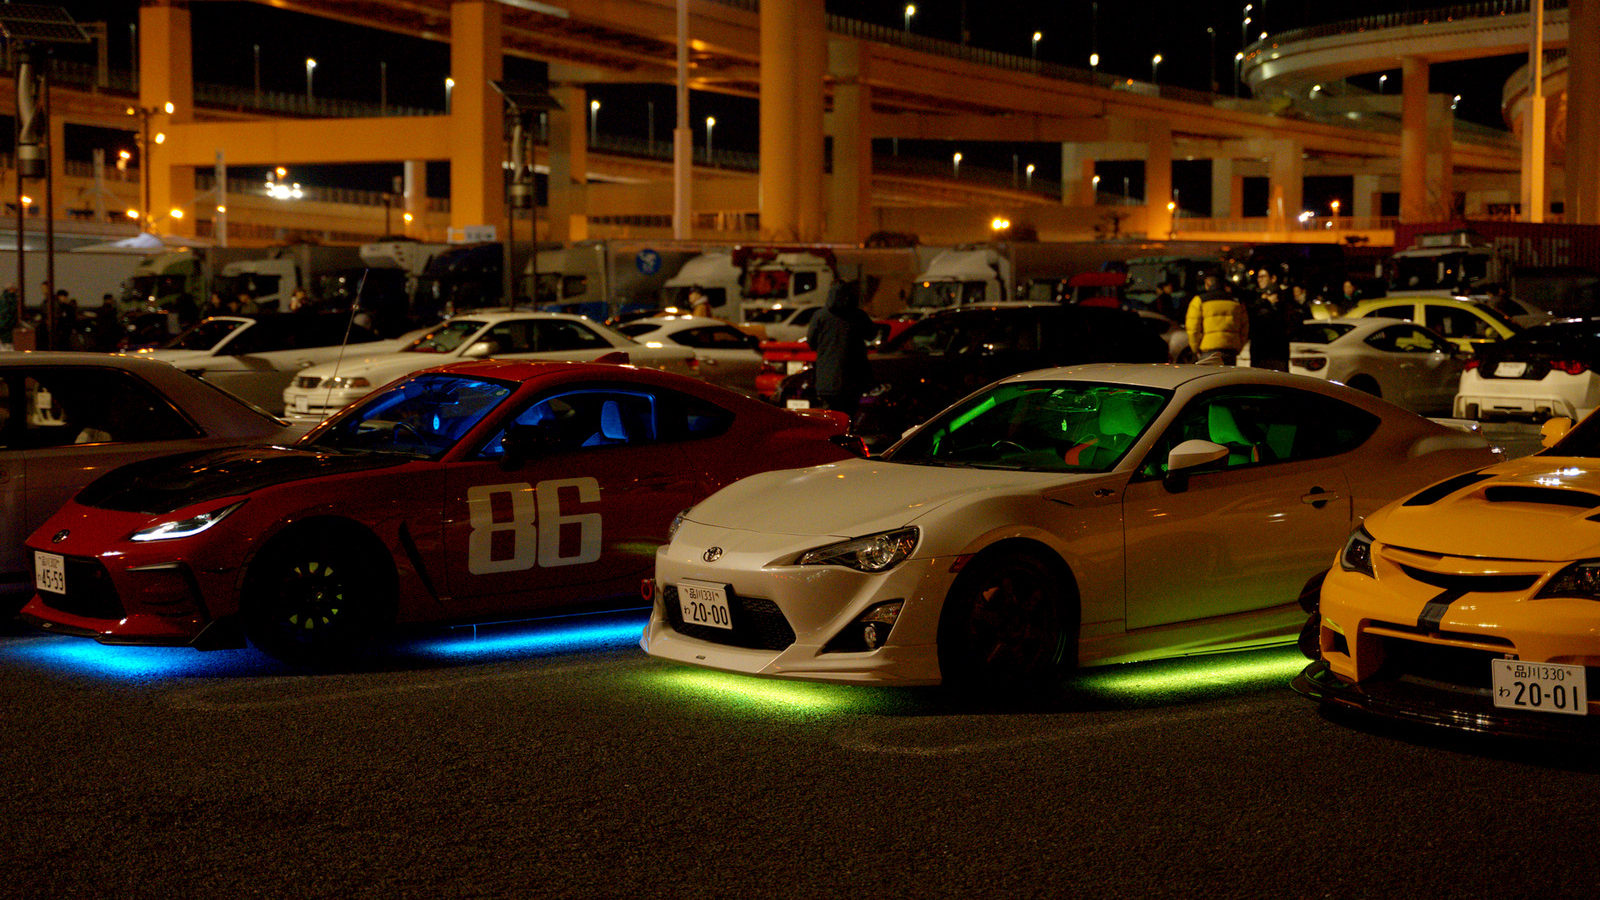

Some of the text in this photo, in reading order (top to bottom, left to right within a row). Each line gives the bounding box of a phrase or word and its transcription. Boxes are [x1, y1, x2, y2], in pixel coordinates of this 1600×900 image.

[467, 476, 602, 575] 86
[43, 569, 64, 591] 45-59
[683, 601, 728, 625] わ 20-00
[1499, 681, 1579, 711] わ 20-01
